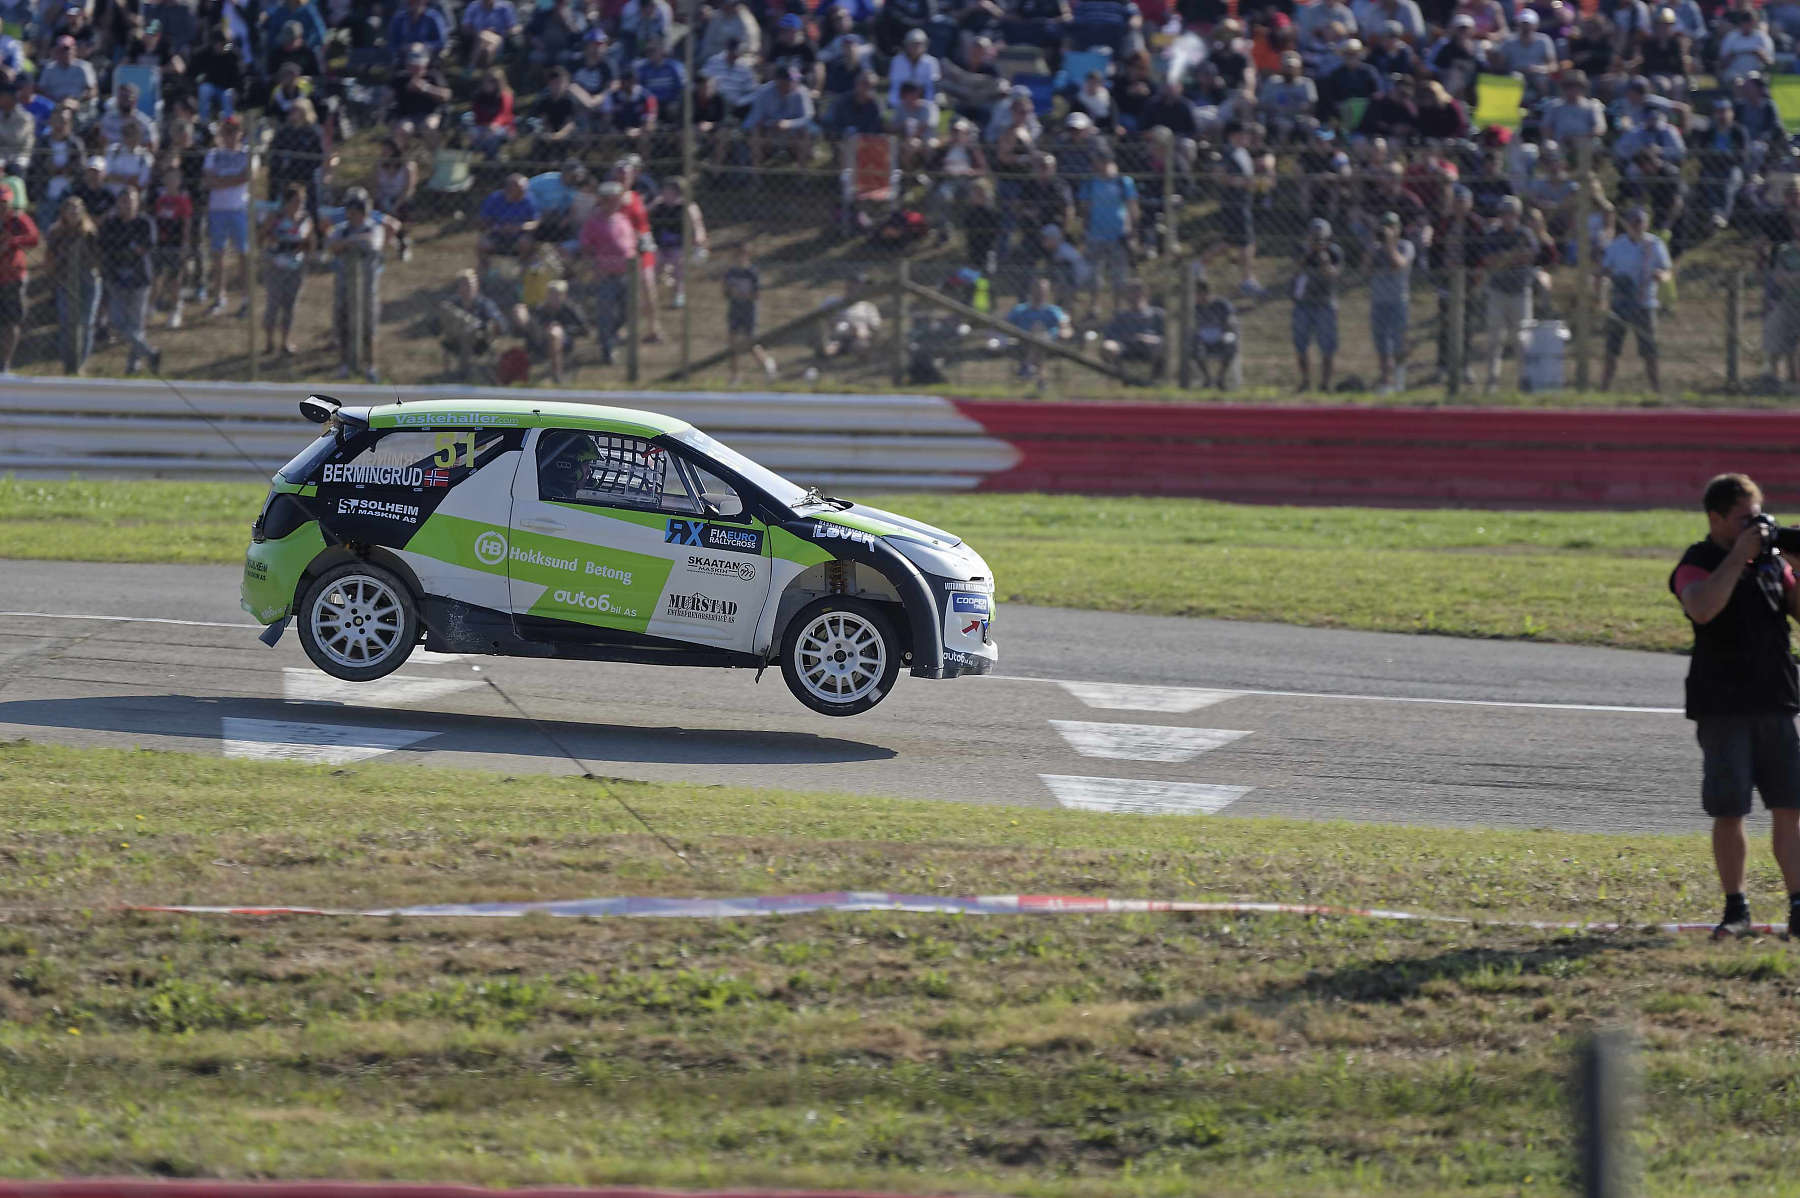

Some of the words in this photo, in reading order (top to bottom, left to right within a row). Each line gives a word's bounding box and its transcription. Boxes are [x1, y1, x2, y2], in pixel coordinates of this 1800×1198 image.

[395, 412, 520, 425] Vaskehaller.com
[434, 433, 476, 468] 51
[323, 463, 423, 487] BERMINGRUD
[358, 509, 400, 520] MASKIN
[402, 516, 417, 524] AS
[360, 499, 419, 516] SOLHEIM
[709, 536, 756, 549] RALLYCROSS
[508, 545, 578, 572] Hokksund
[585, 561, 633, 586] Betong
[688, 556, 741, 570] SKAATAN
[553, 589, 611, 612] auto6
[610, 606, 621, 615] bil
[624, 609, 637, 617] AS
[668, 593, 738, 616] MURSTAD
